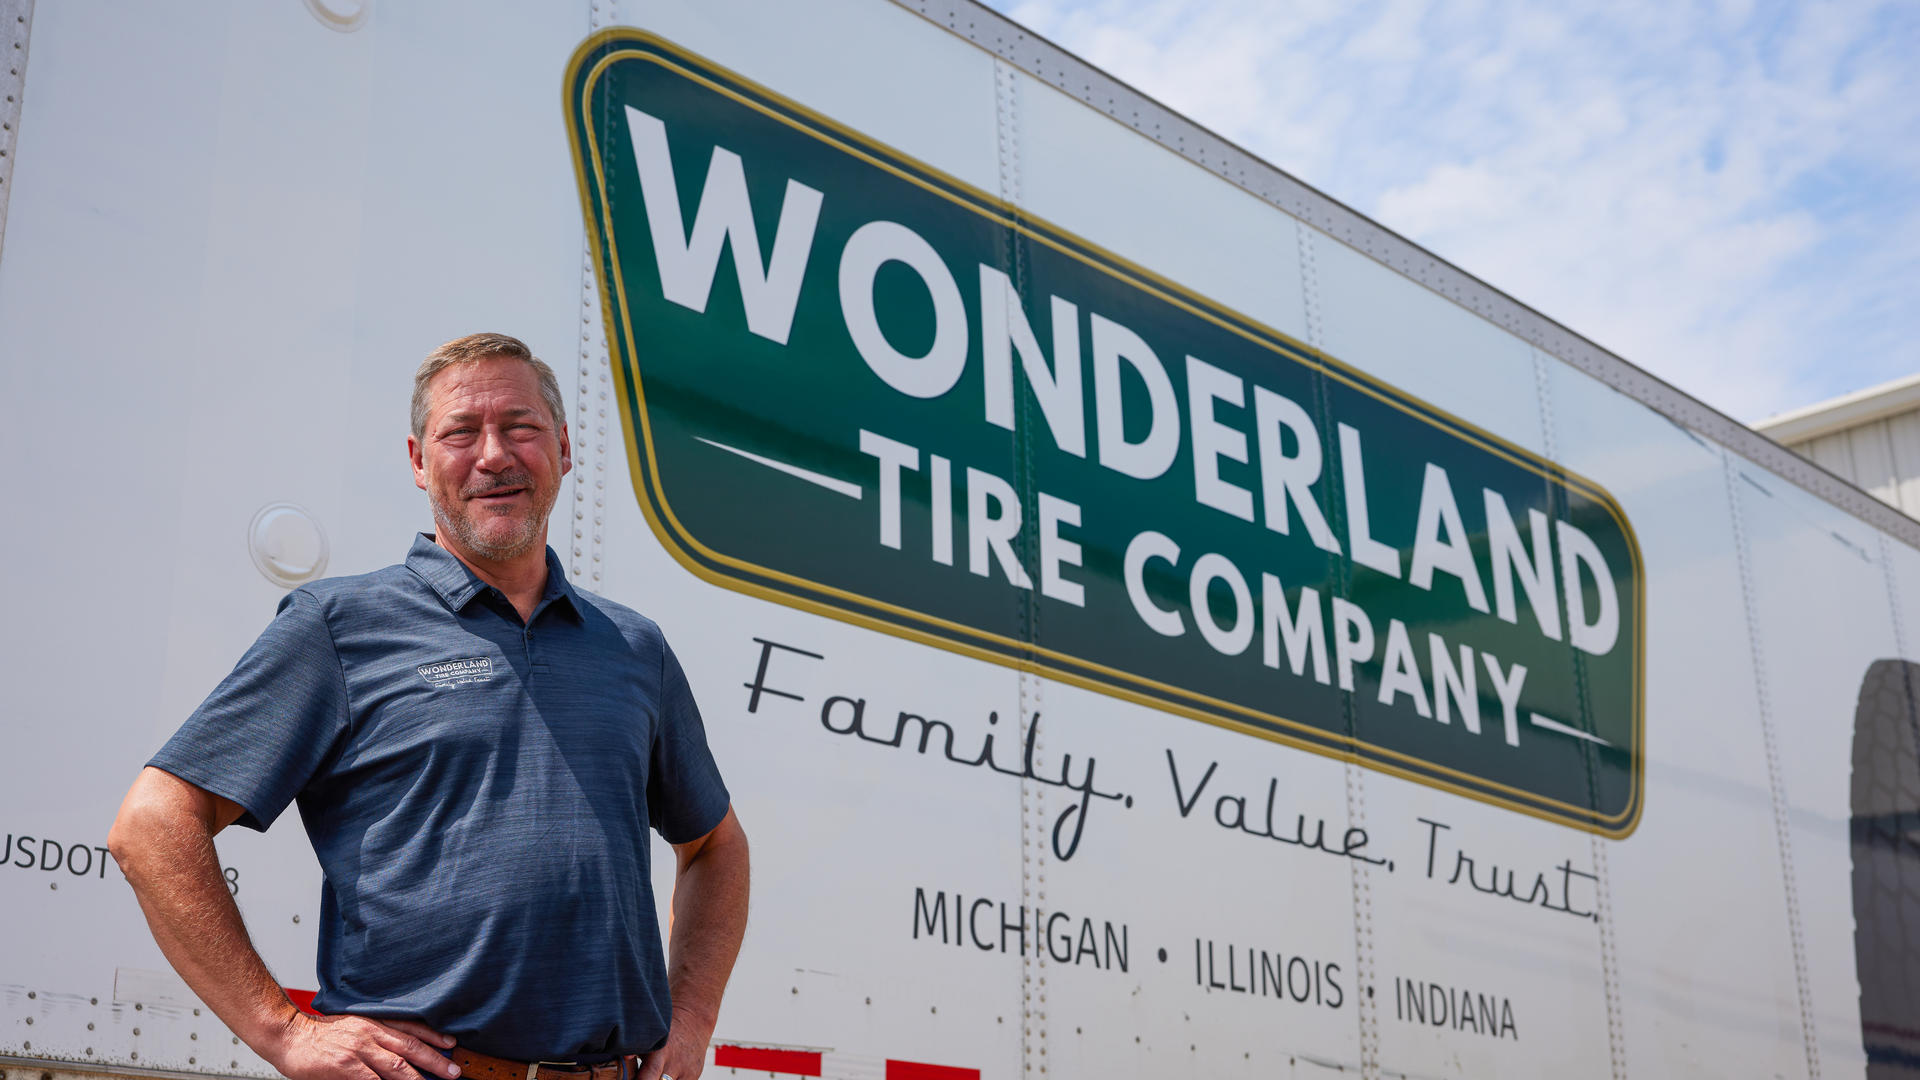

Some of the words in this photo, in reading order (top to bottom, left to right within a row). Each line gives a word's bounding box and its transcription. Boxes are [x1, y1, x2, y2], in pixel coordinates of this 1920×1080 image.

[623, 104, 1620, 657] WONDERLAND
[421, 660, 488, 675] WONDERLAND
[450, 668, 480, 676] COMPANY
[859, 428, 1085, 608] TIRE
[1123, 530, 1528, 748] COMPANY
[743, 637, 1134, 862] Family.
[1166, 749, 1395, 873] Value.
[913, 886, 1129, 974] MICHIGAN
[1196, 938, 1344, 1009] ILLINOIS
[1395, 977, 1519, 1041] INDIANA
